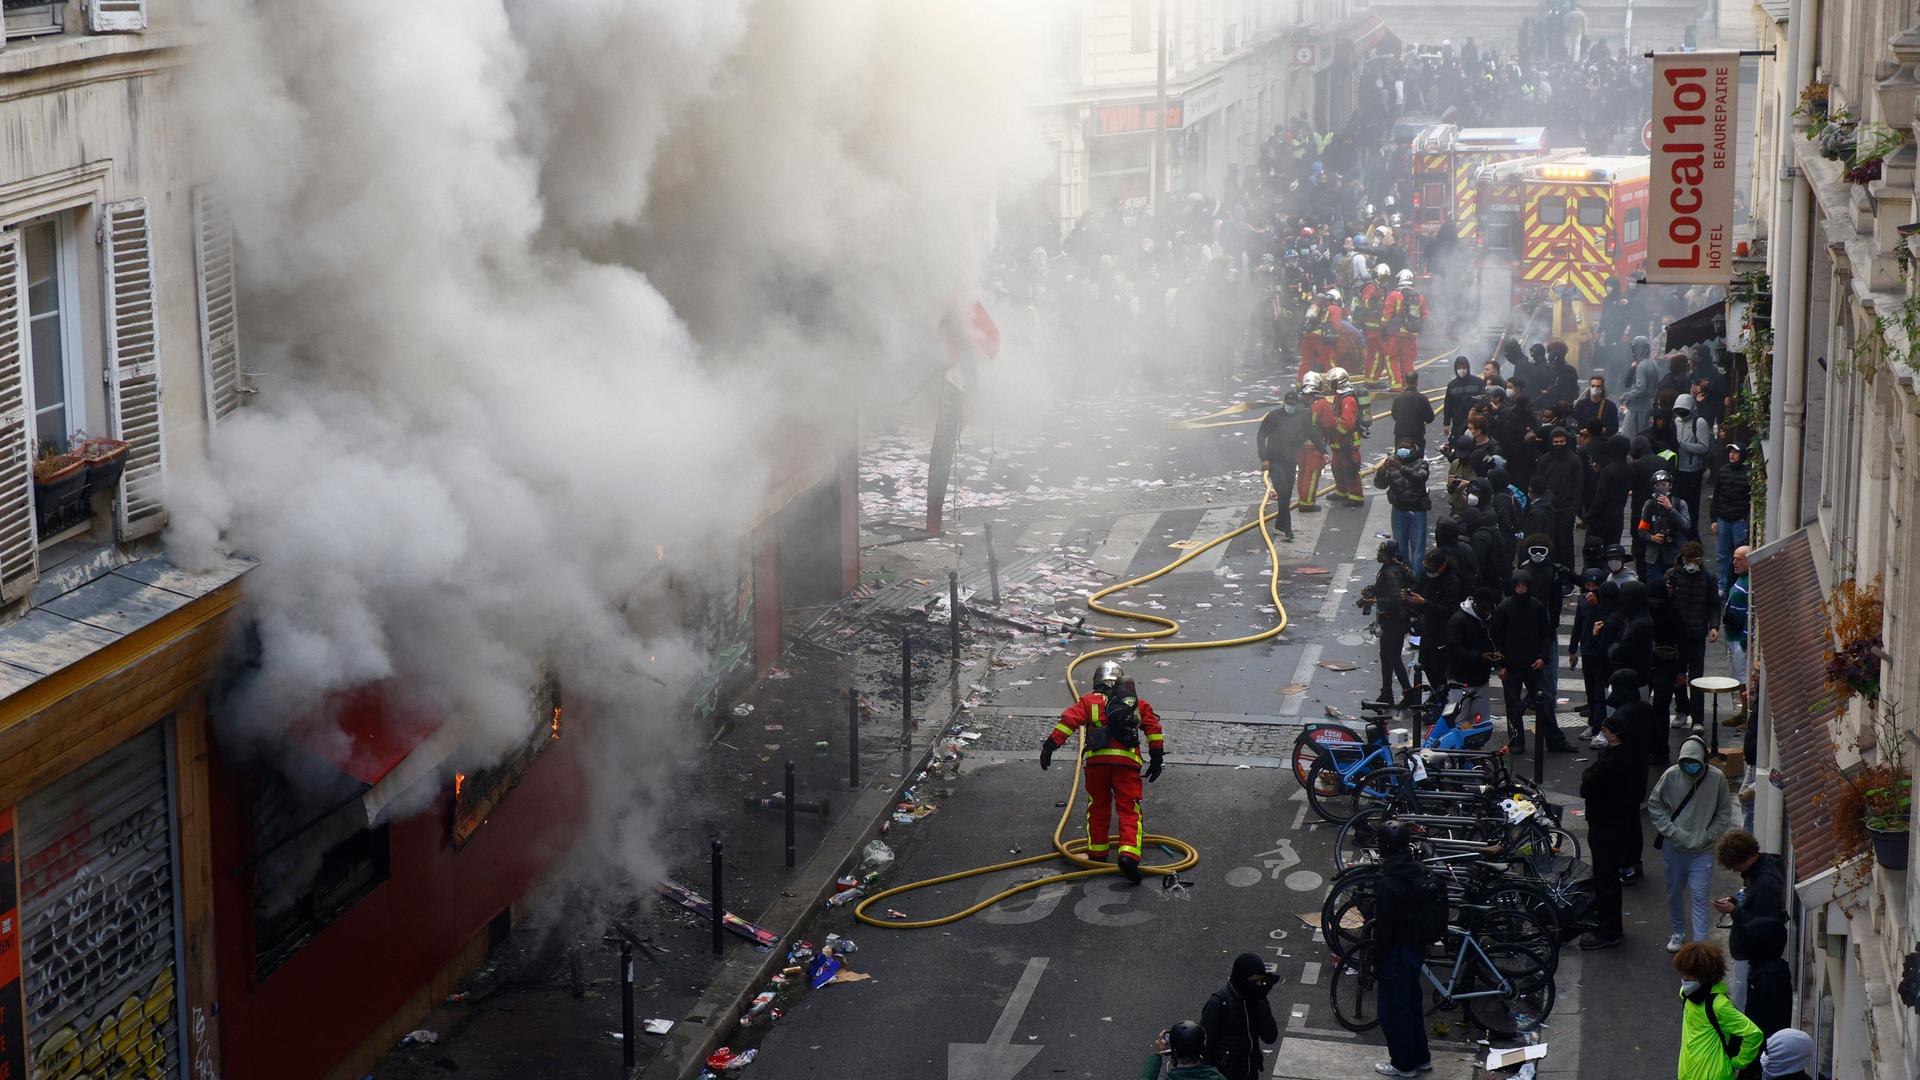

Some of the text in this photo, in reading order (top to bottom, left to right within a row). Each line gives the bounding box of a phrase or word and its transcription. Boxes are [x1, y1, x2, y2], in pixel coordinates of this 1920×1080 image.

[1658, 68, 1707, 269] Local 101
[1707, 67, 1729, 269] HÔTEL BEAUREPAIRE
[1324, 730, 1342, 738] ESSAI
